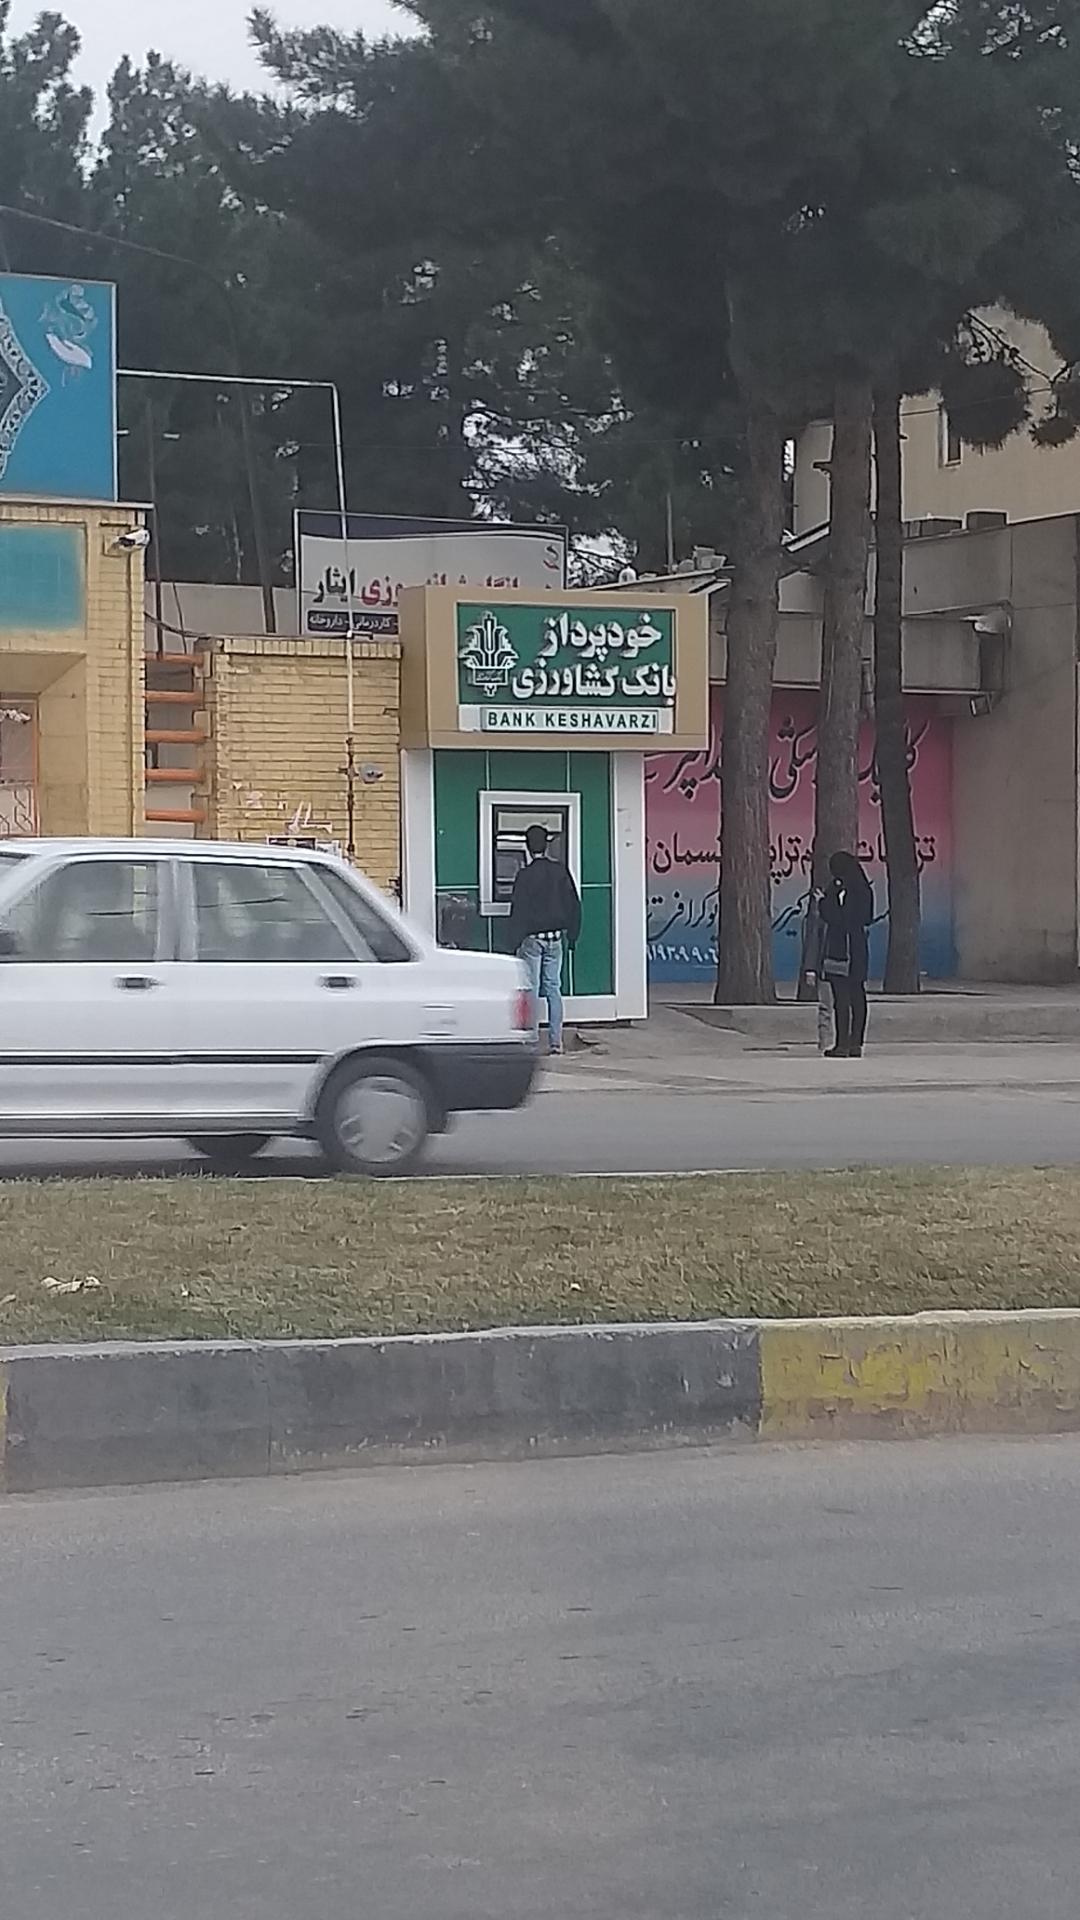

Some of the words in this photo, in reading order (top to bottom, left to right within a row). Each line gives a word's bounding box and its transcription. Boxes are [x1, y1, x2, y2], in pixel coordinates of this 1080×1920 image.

[312, 566, 356, 603] ایثار
[538, 612, 662, 662] خودپرداز
[512, 657, 620, 699] کشاورزی
[622, 661, 677, 706] بانک
[488, 711, 536, 728] BANK
[545, 713, 657, 729] KESHAVARZI
